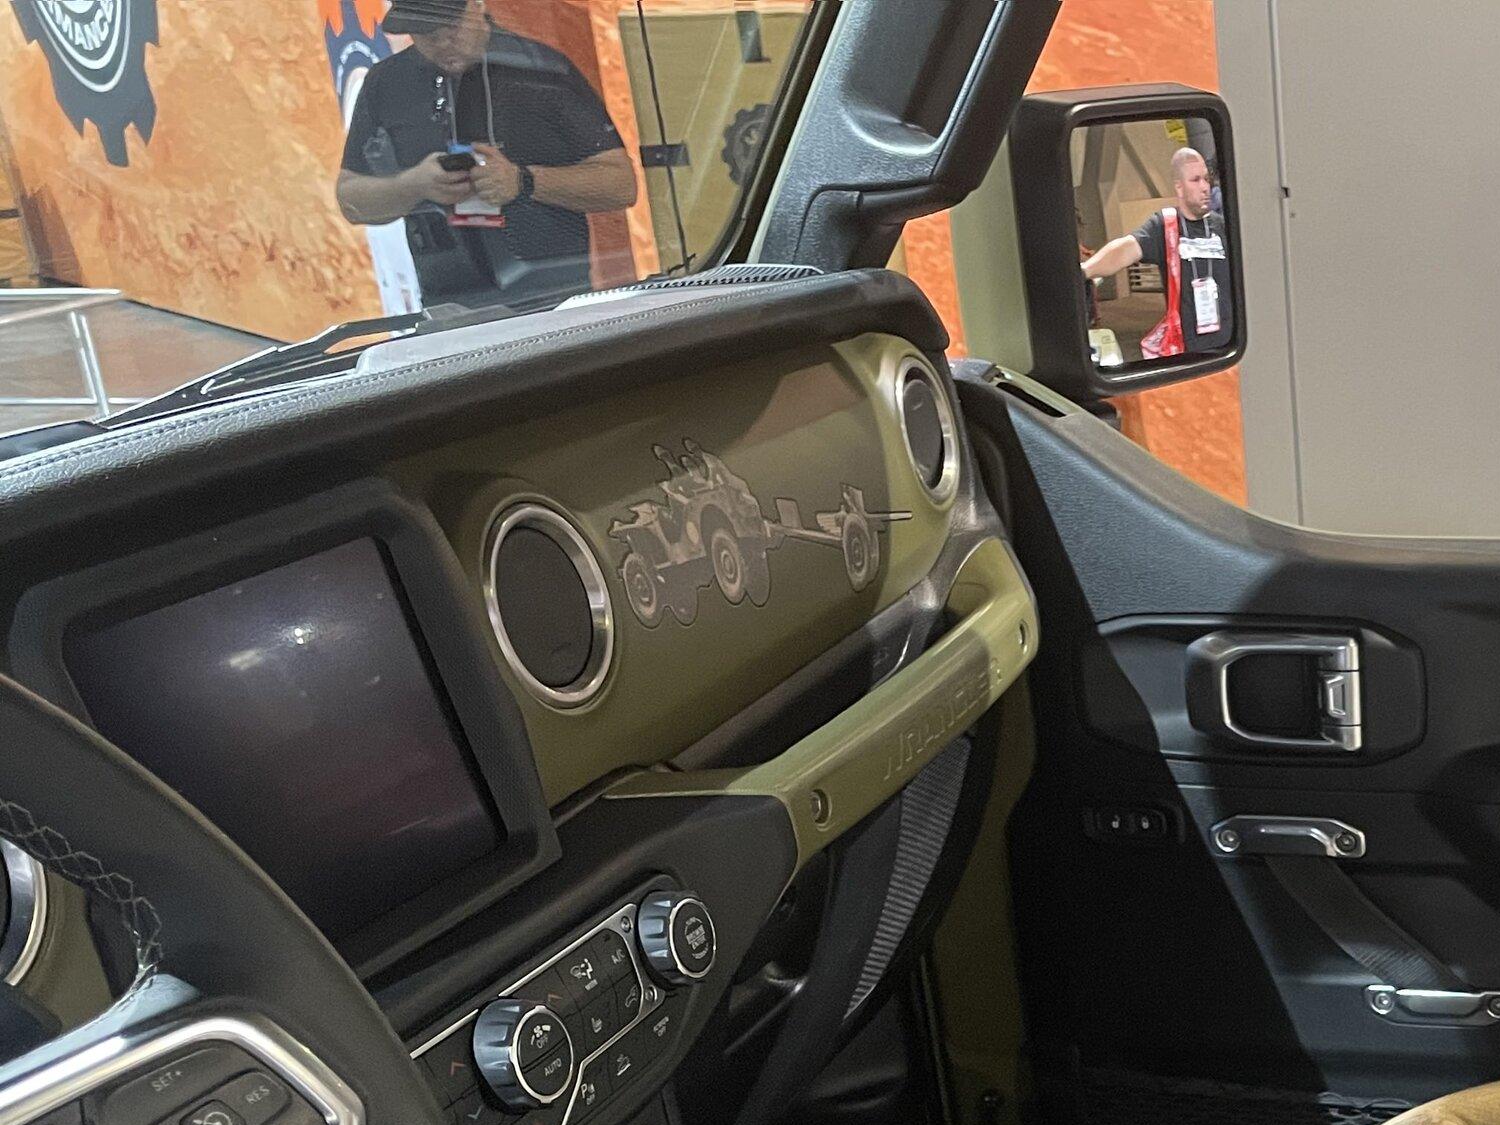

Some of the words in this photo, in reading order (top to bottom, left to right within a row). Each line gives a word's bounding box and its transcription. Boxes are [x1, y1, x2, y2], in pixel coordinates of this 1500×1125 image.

[611, 949, 625, 964] A/C
[544, 1058, 561, 1076] AUTO
[245, 1085, 270, 1104] RES
